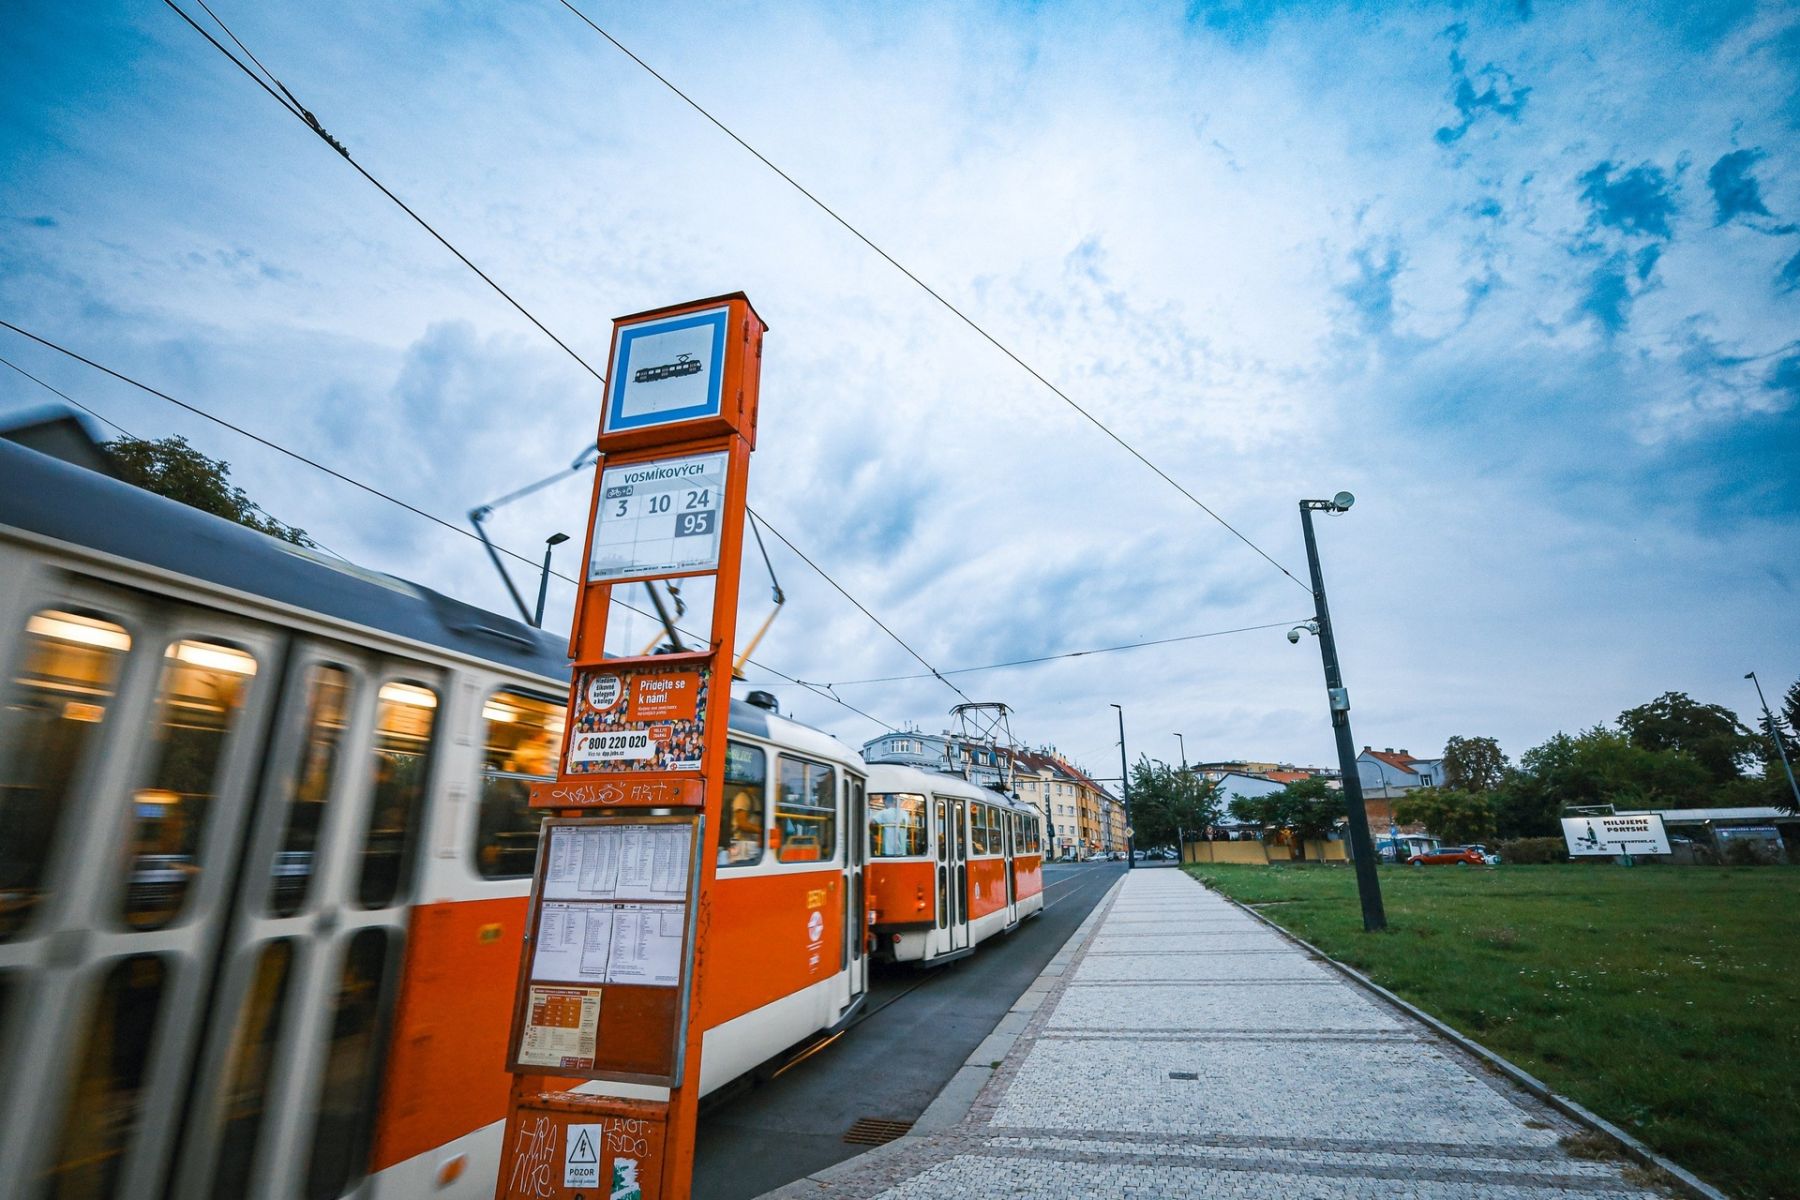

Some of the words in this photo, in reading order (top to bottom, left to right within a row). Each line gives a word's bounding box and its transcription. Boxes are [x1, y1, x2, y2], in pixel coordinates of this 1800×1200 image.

[624, 463, 705, 484] VOSMÍKOVÝCH
[615, 499, 628, 517] 3
[648, 494, 671, 514] 10
[685, 489, 710, 510] 24
[684, 513, 707, 534] 95
[675, 680, 686, 689] se
[638, 693, 644, 704] k
[646, 692, 668, 704] nám!
[588, 737, 606, 750] 800
[608, 736, 626, 749] 220
[629, 735, 647, 748] 020
[569, 1168, 594, 1176] POZOR
